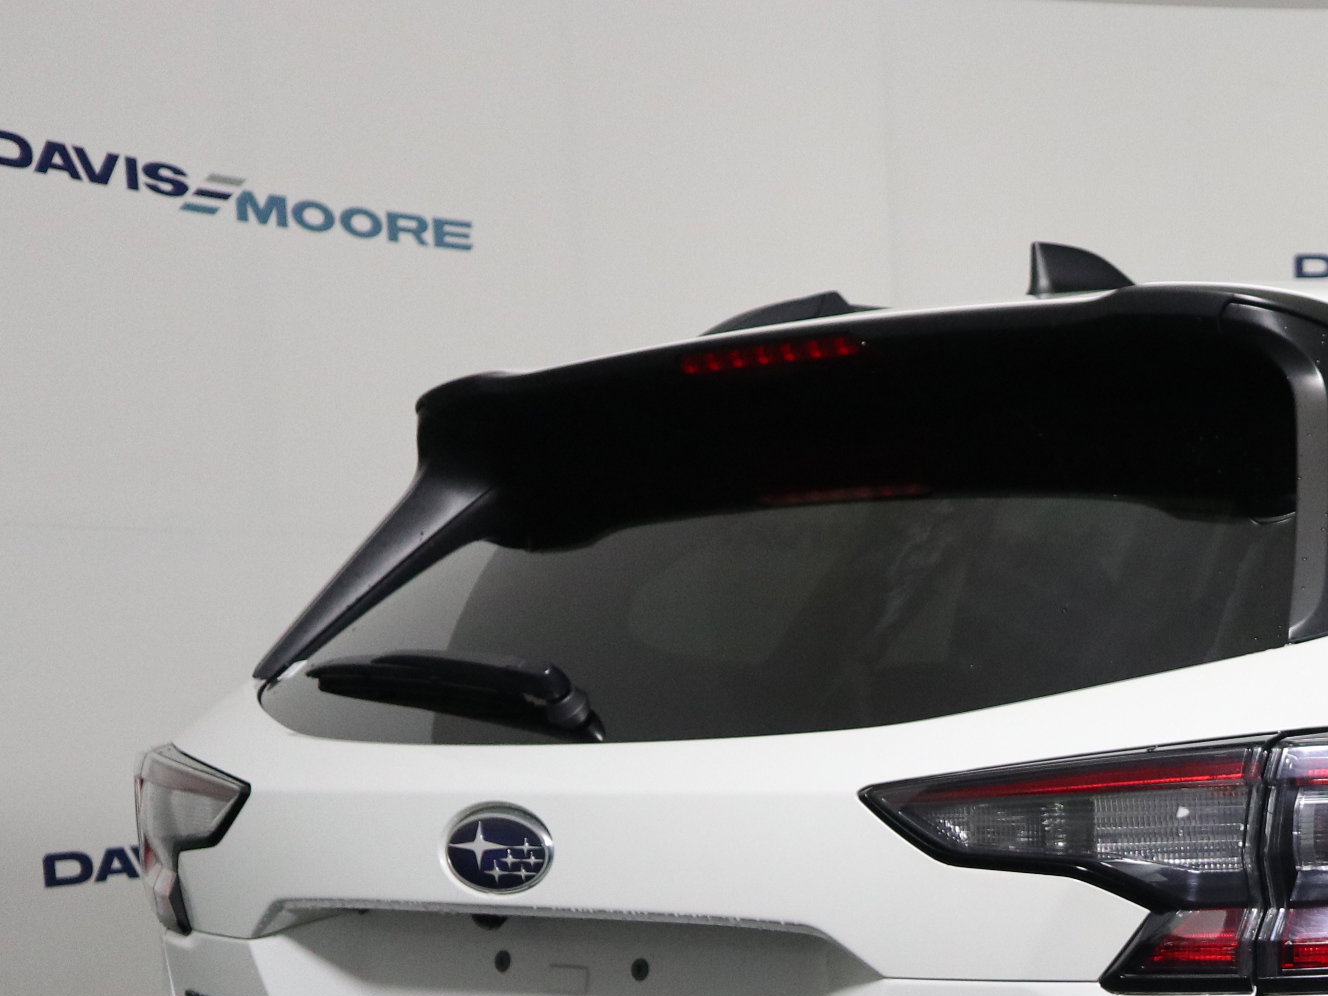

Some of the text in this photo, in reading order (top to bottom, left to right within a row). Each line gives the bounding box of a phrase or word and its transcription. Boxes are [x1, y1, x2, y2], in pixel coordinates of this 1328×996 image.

[0, 130, 473, 250] DAVIS MOORE
[42, 845, 141, 888] DA
